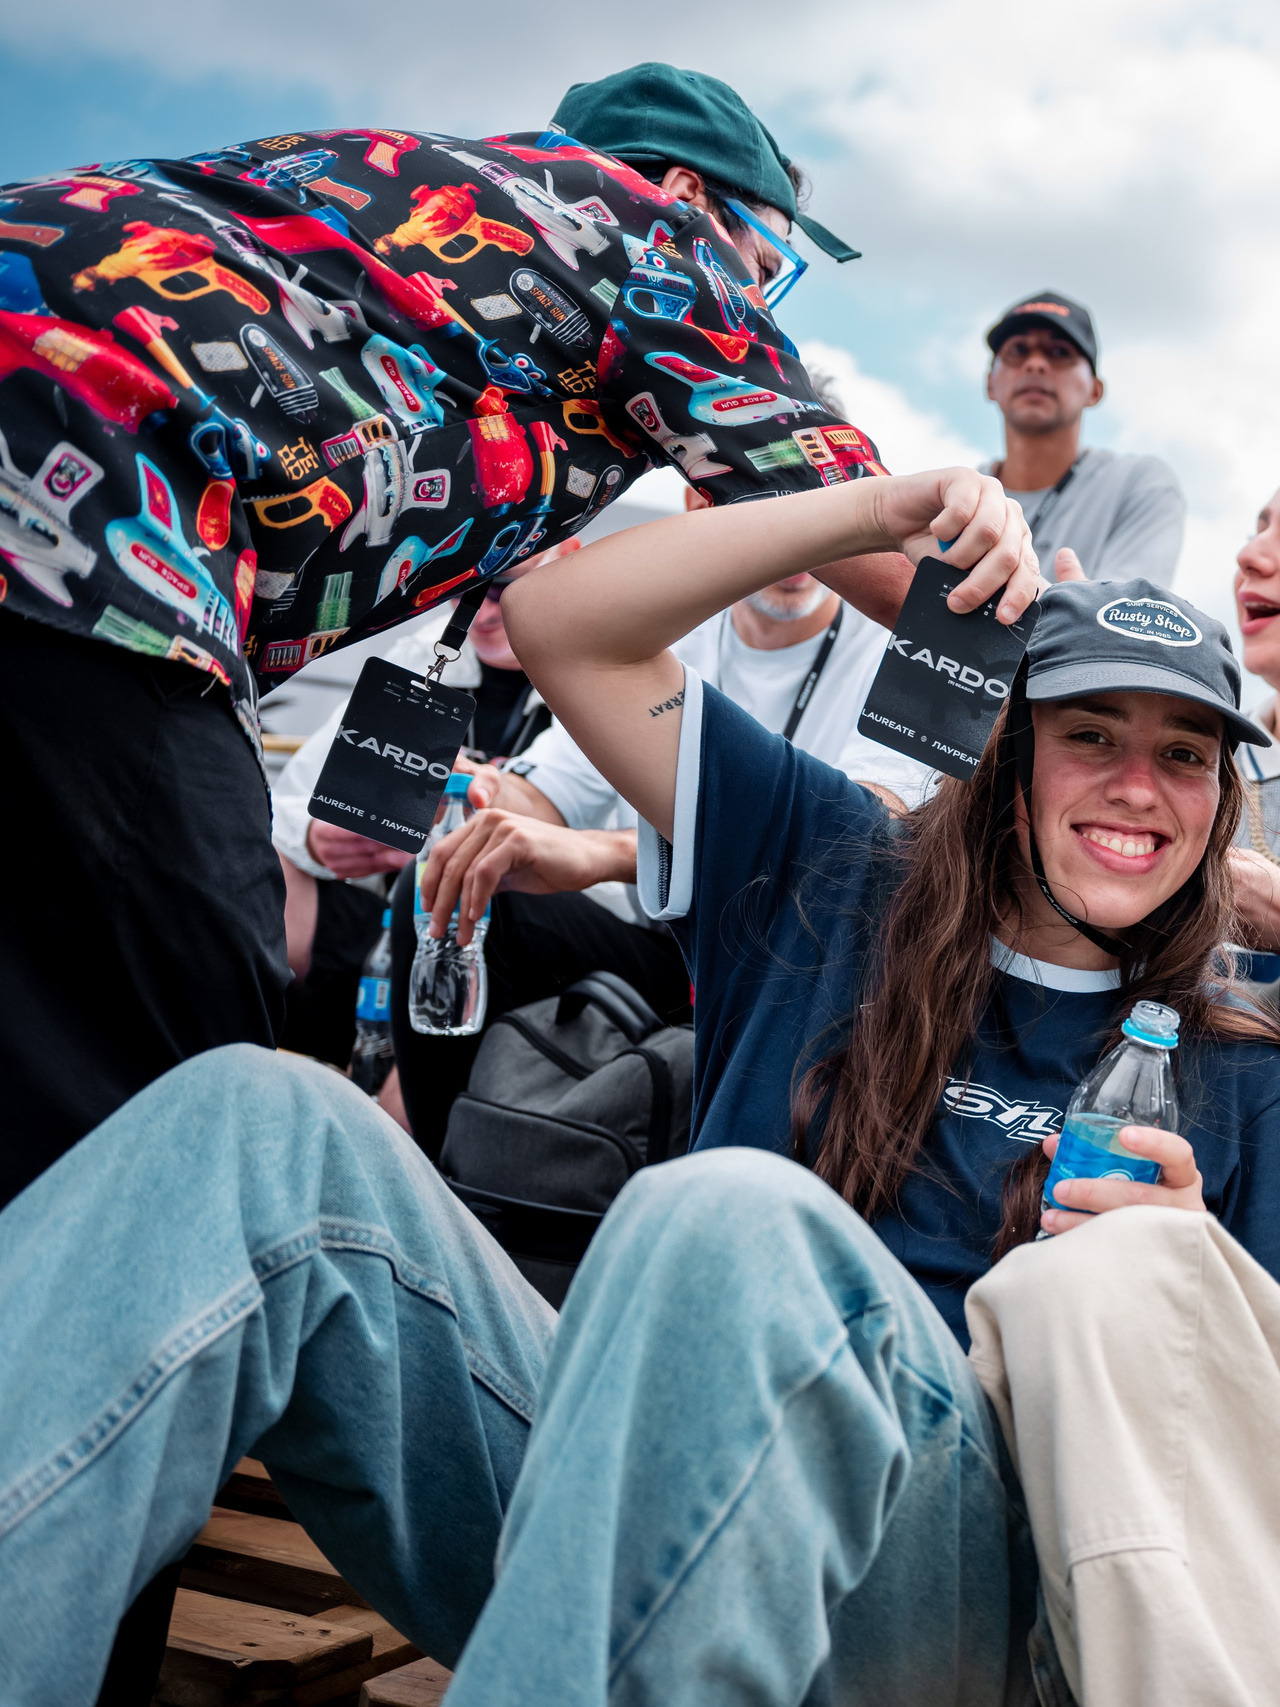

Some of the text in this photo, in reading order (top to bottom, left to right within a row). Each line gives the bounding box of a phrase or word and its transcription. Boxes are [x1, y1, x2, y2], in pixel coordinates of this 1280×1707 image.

[530, 286, 567, 322] SPACE GUN
[721, 394, 771, 409] SPACE GUN
[138, 550, 190, 593] SPACE GUN
[1108, 608, 1193, 638] Rusty Shop
[1146, 602, 1178, 618] SERVICES
[1129, 626, 1145, 634] EST.
[887, 634, 1010, 699] KARDO
[649, 688, 685, 717] ERRAT
[861, 708, 916, 738] LAUREATE
[335, 725, 451, 780] KARDO
[932, 740, 980, 767] ЛАУРЕАТ
[311, 792, 365, 818] LAUREATE
[381, 818, 428, 841] ЛАУРЕАТ
